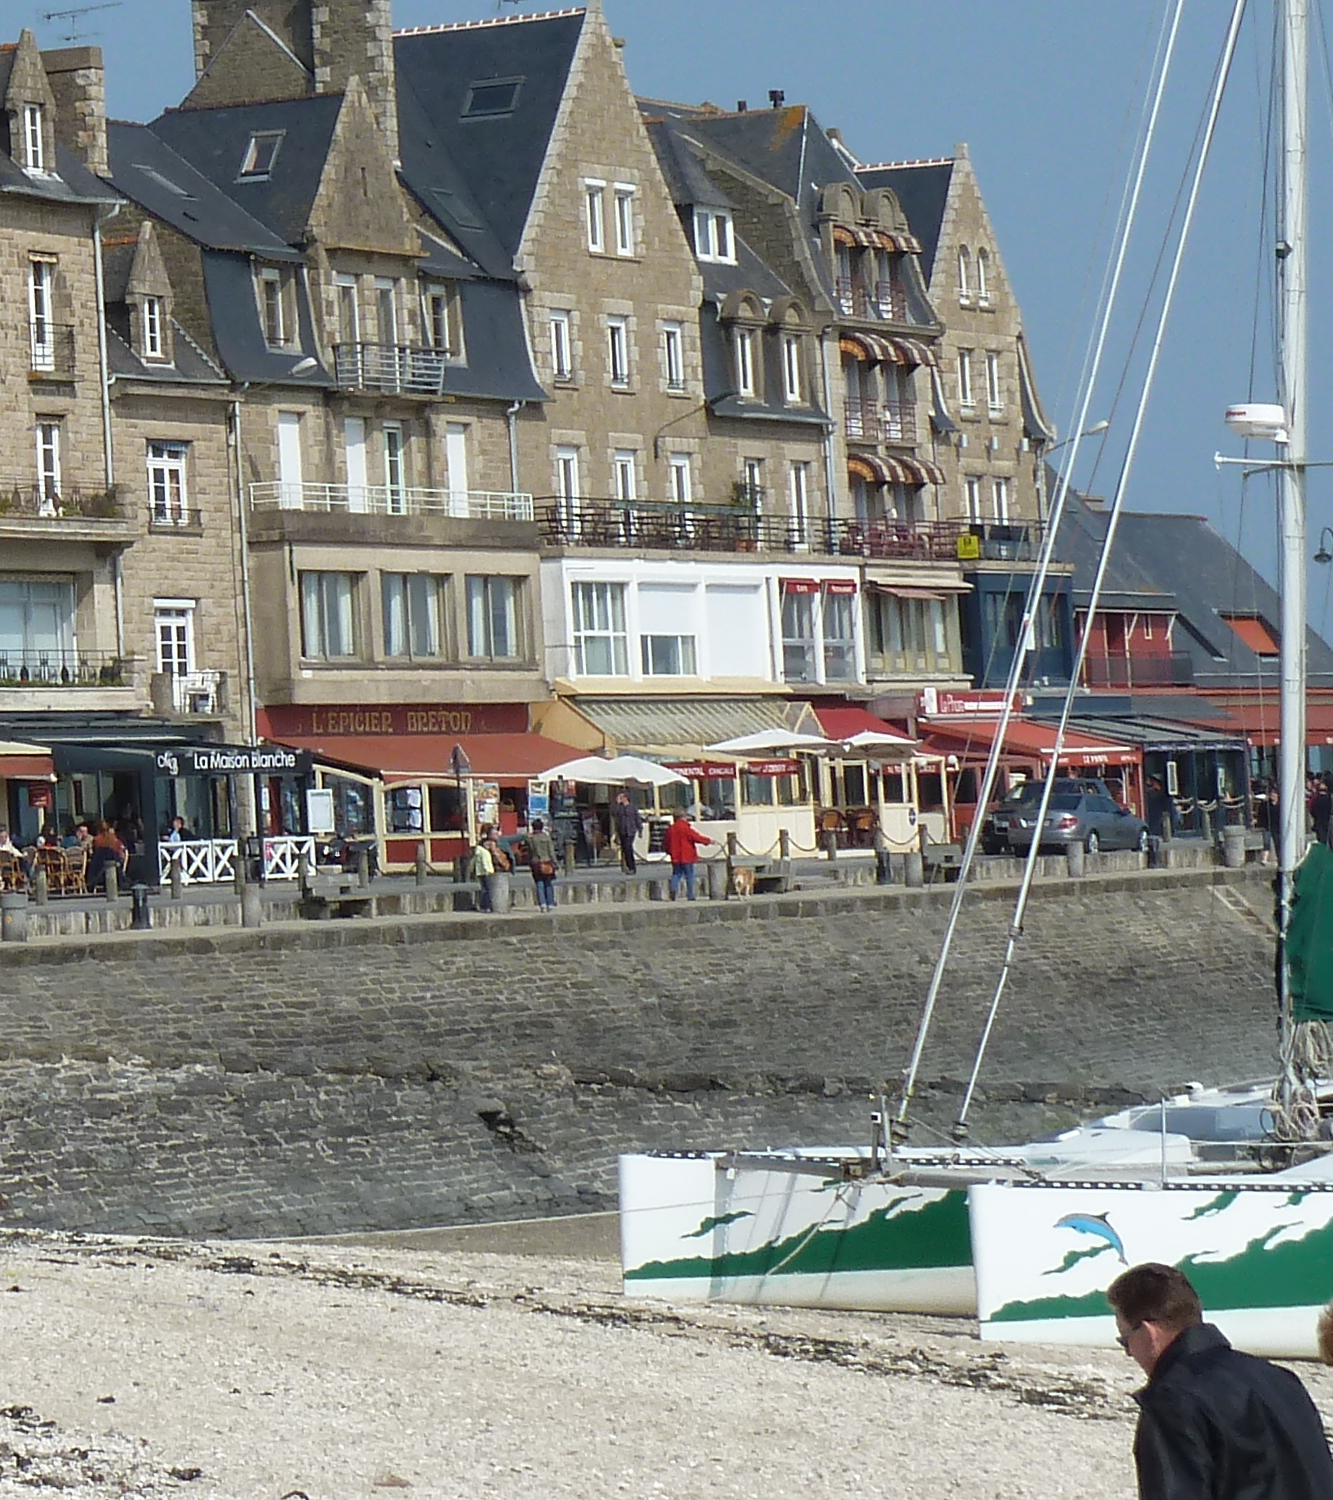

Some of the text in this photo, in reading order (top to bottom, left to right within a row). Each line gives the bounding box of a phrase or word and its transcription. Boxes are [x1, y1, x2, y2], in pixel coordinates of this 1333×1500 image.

[406, 711, 472, 732] BRETON
[194, 751, 296, 769] La Maison Blanche
